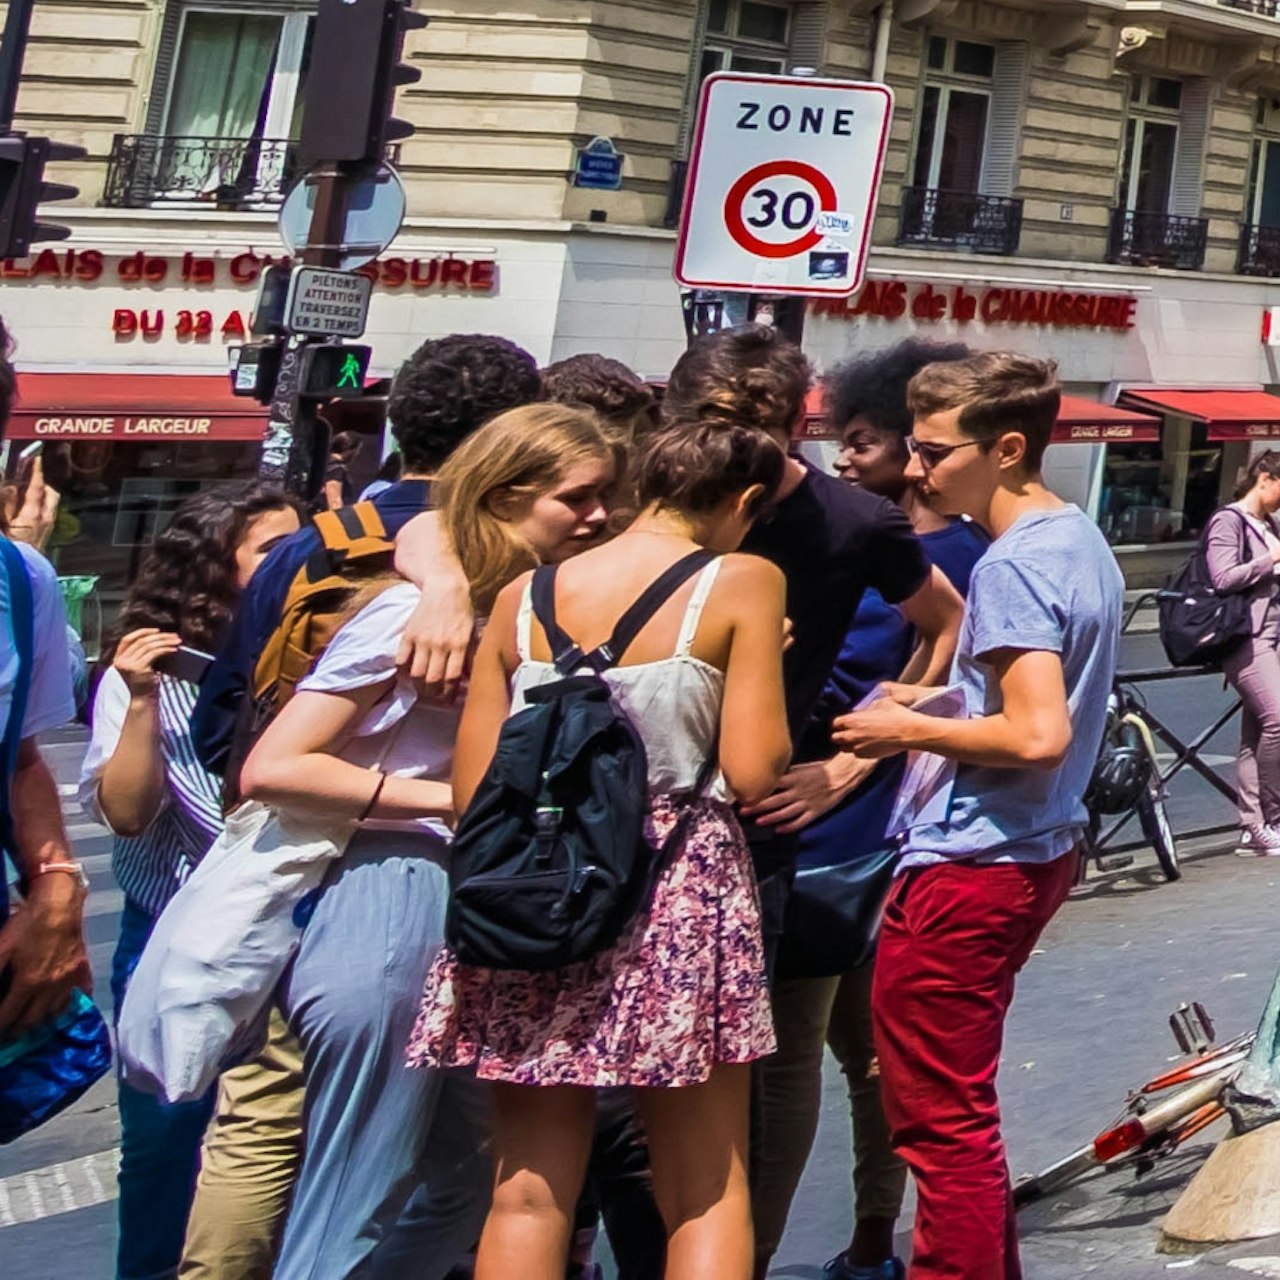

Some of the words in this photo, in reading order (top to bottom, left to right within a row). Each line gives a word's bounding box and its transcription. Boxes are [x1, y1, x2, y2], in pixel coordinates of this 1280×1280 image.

[737, 103, 855, 136] ZONE
[747, 189, 815, 231] 30
[118, 251, 168, 282] de
[182, 251, 215, 284] la
[304, 288, 362, 304] ATTENTION
[912, 284, 947, 320] de
[980, 287, 1137, 328] CHAUSSURE
[112, 309, 164, 334] DU
[300, 302, 361, 318] TRAVERSEZ
[295, 316, 311, 327] EN
[313, 317, 321, 328] 2
[324, 319, 359, 332] TEMPS
[35, 418, 114, 434] GRANDE
[124, 418, 211, 434] LARGEUR
